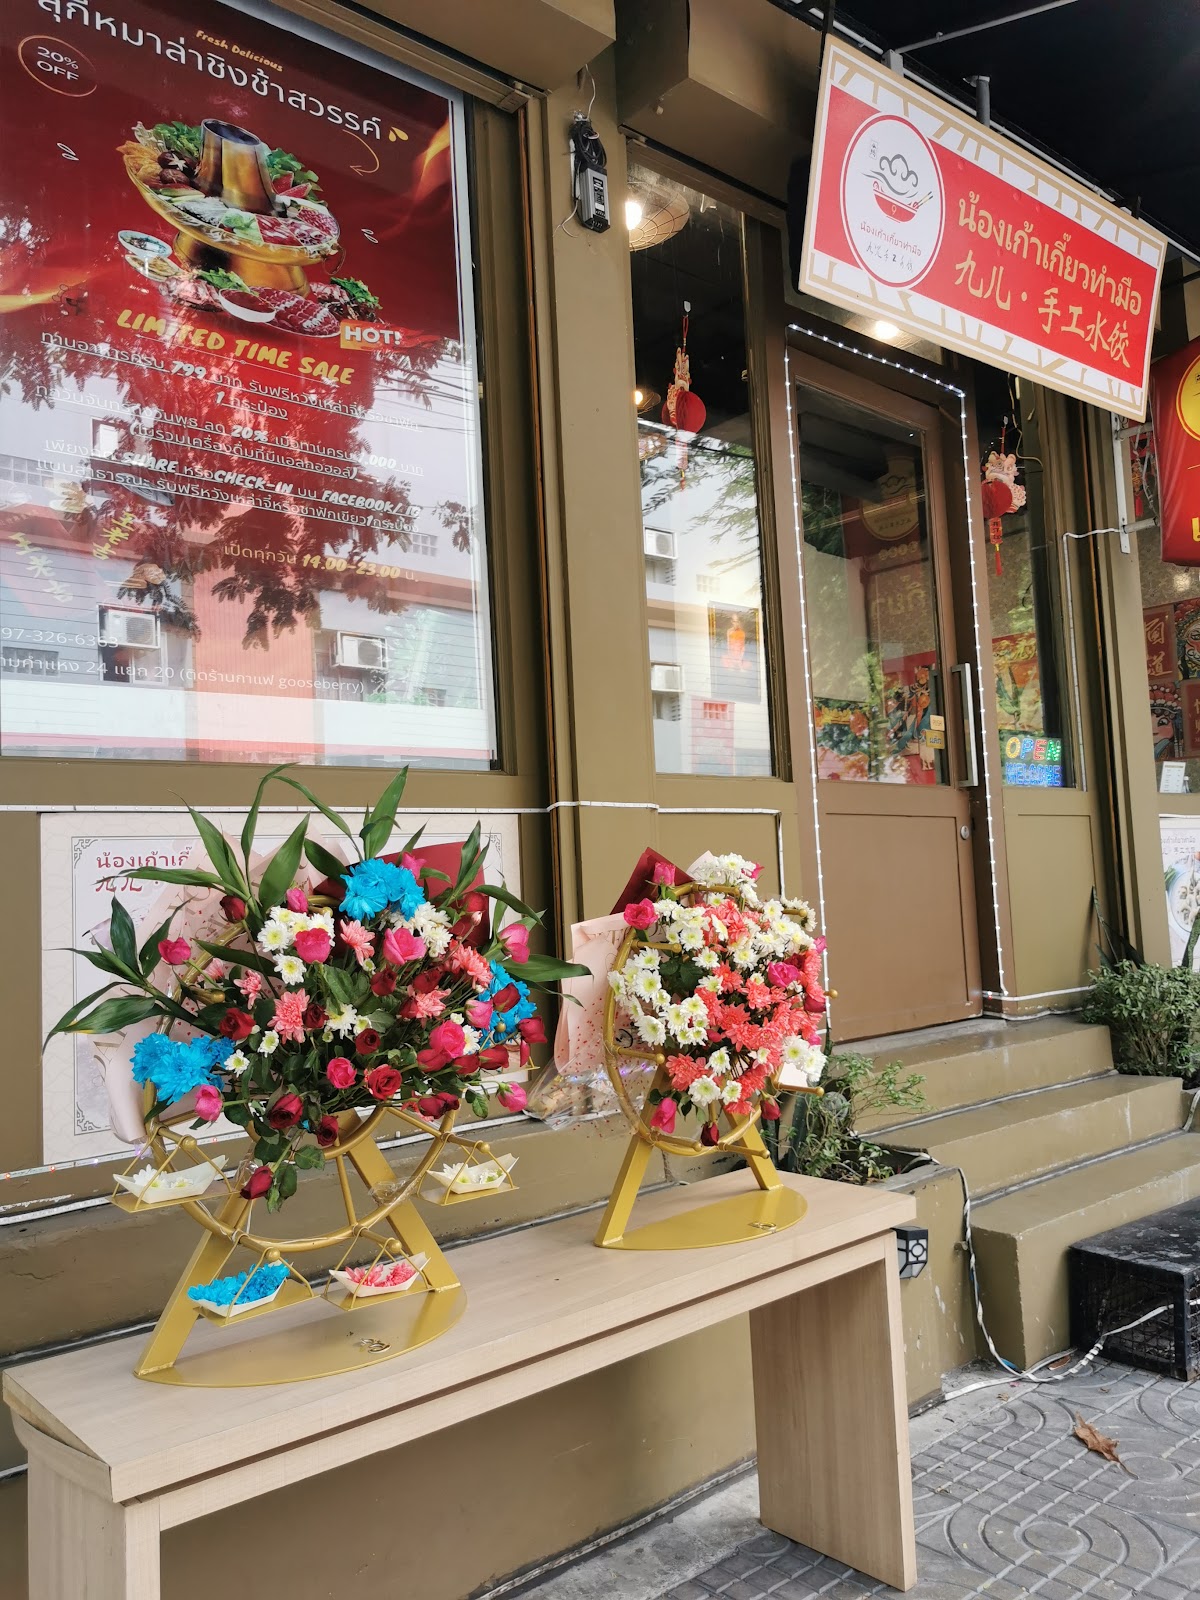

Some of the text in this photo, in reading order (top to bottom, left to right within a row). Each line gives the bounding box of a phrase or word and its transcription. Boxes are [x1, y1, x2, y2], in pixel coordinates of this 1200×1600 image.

[37, 46, 79, 70] 20%
[195, 30, 283, 72] Fresh Delicious
[36, 60, 80, 81] OFF
[38, 0, 381, 140] สุกีหมาล่าชิงช้าสวรรค์
[958, 190, 1142, 316] น้องเก้าเกี๊ยวทำมือ
[117, 309, 355, 385] LIMITED TIME SALE
[344, 325, 402, 346] HOT!
[171, 360, 206, 379] 799
[213, 373, 242, 388] บาท
[214, 391, 225, 405] 1
[204, 420, 226, 434] ลด
[231, 425, 268, 443] 20%
[121, 451, 178, 474] SHARE
[224, 542, 298, 566] เปิดทุกวัน
[302, 553, 401, 579] 14.00-23.00
[86, 661, 108, 675] 24
[154, 666, 175, 679] 20
[278, 676, 365, 694] gooseberry)
[1005, 736, 1062, 762] OPEN
[1005, 762, 1063, 787] WELCOME
